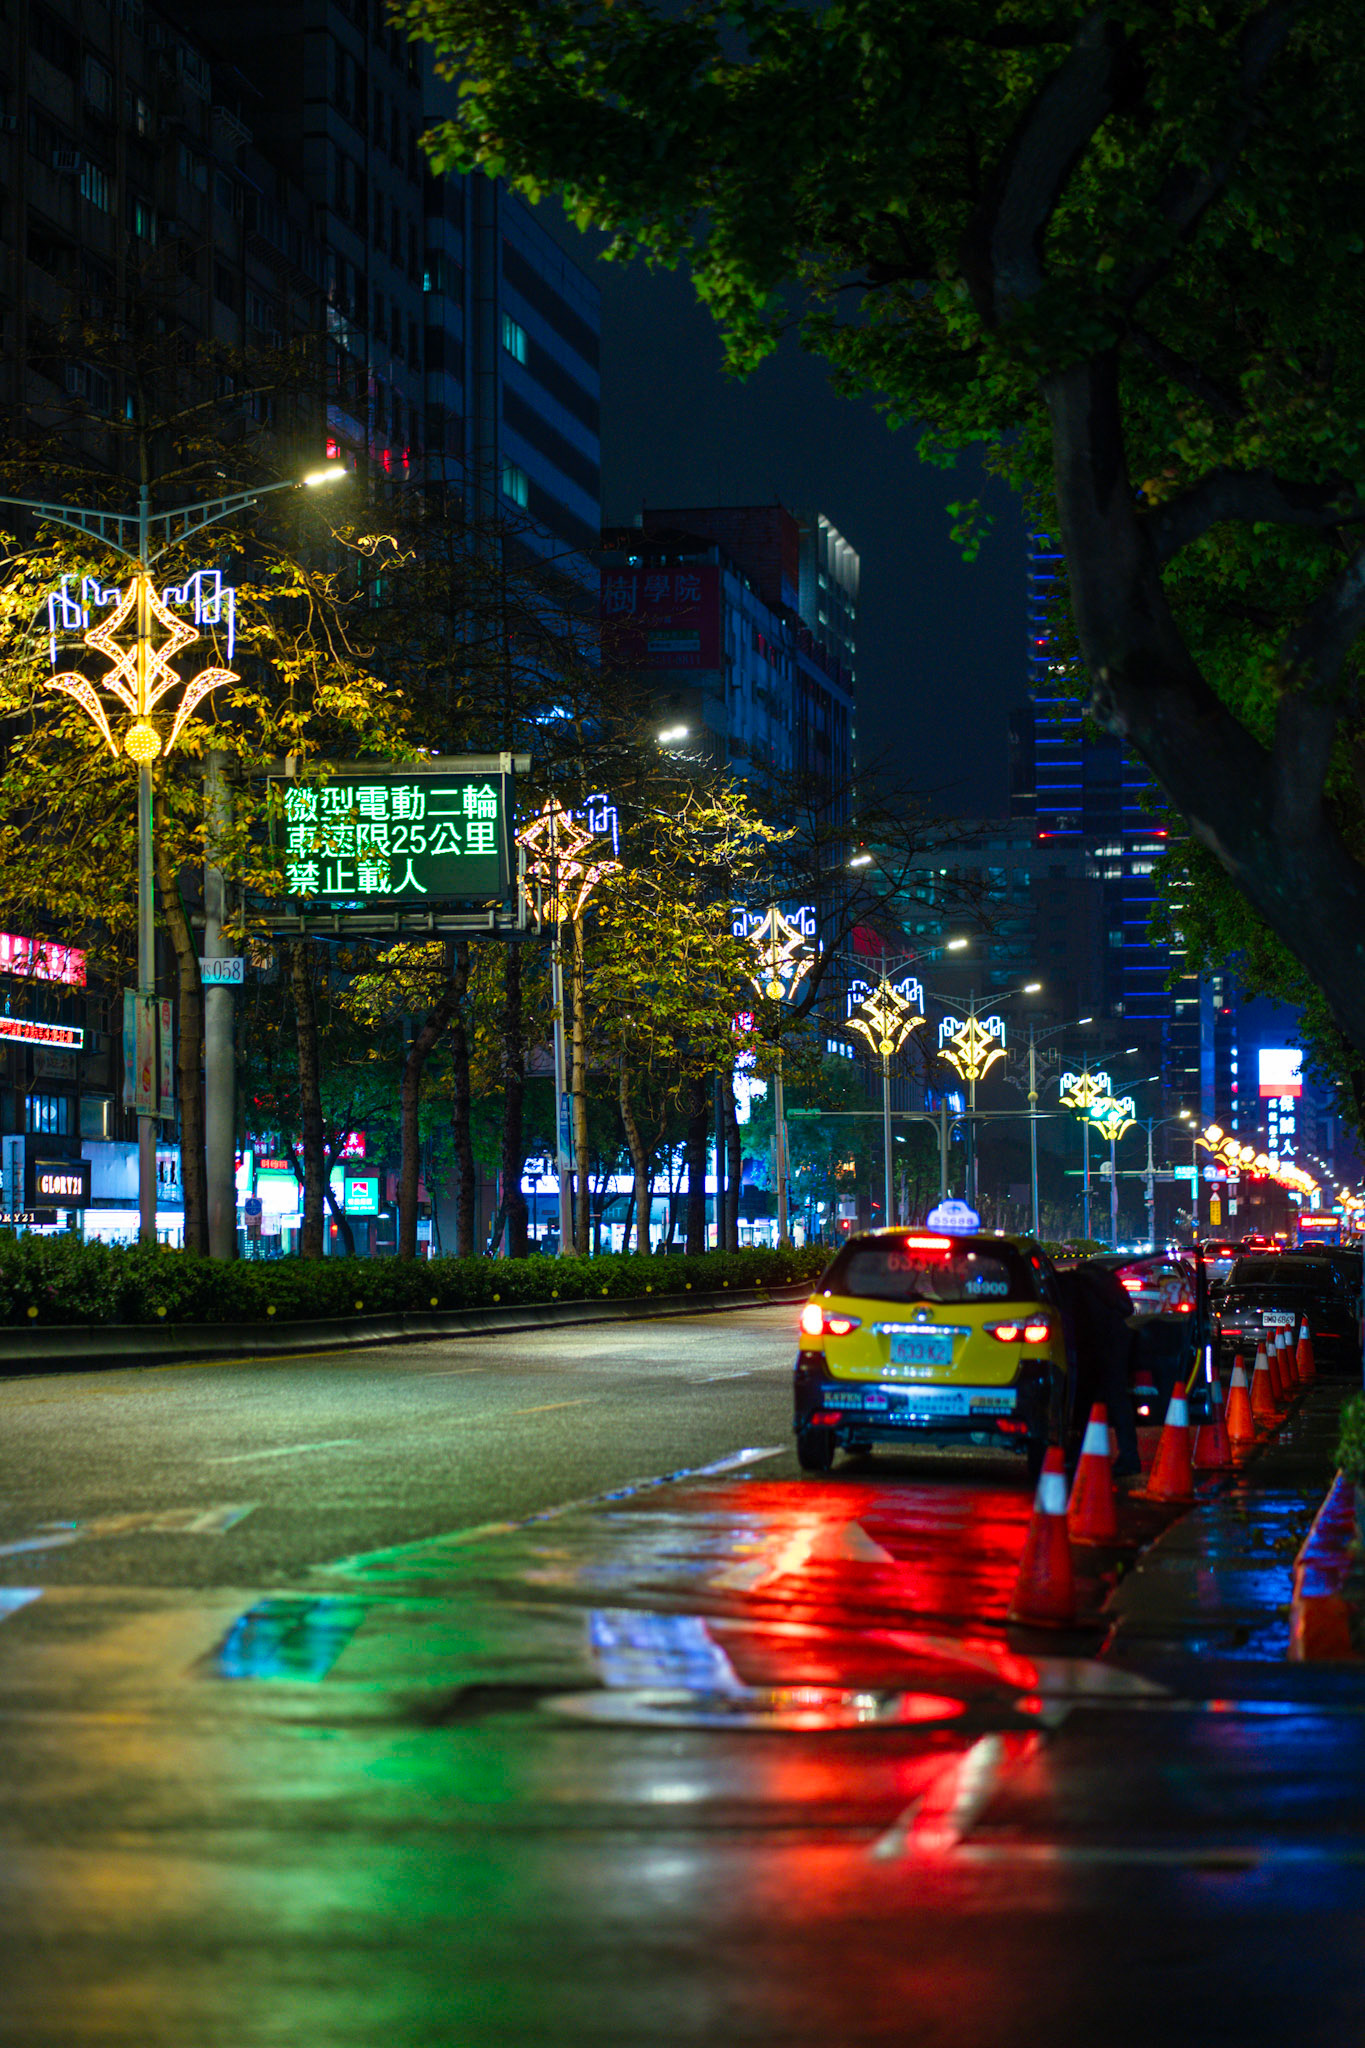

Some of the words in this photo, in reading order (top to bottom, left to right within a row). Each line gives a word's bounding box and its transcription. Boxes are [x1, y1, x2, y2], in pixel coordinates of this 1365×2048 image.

[284, 783, 498, 822] 微型電動二輪
[286, 821, 498, 859] 車速限25公里
[285, 858, 428, 894] 禁止載人
[213, 960, 241, 981] 058
[41, 1175, 82, 1195] GLORY21
[0, 1212, 35, 1222] RY21
[933, 1216, 975, 1225] 55688
[965, 1281, 1009, 1296] 18900
[896, 1343, 946, 1361] 633-K2
